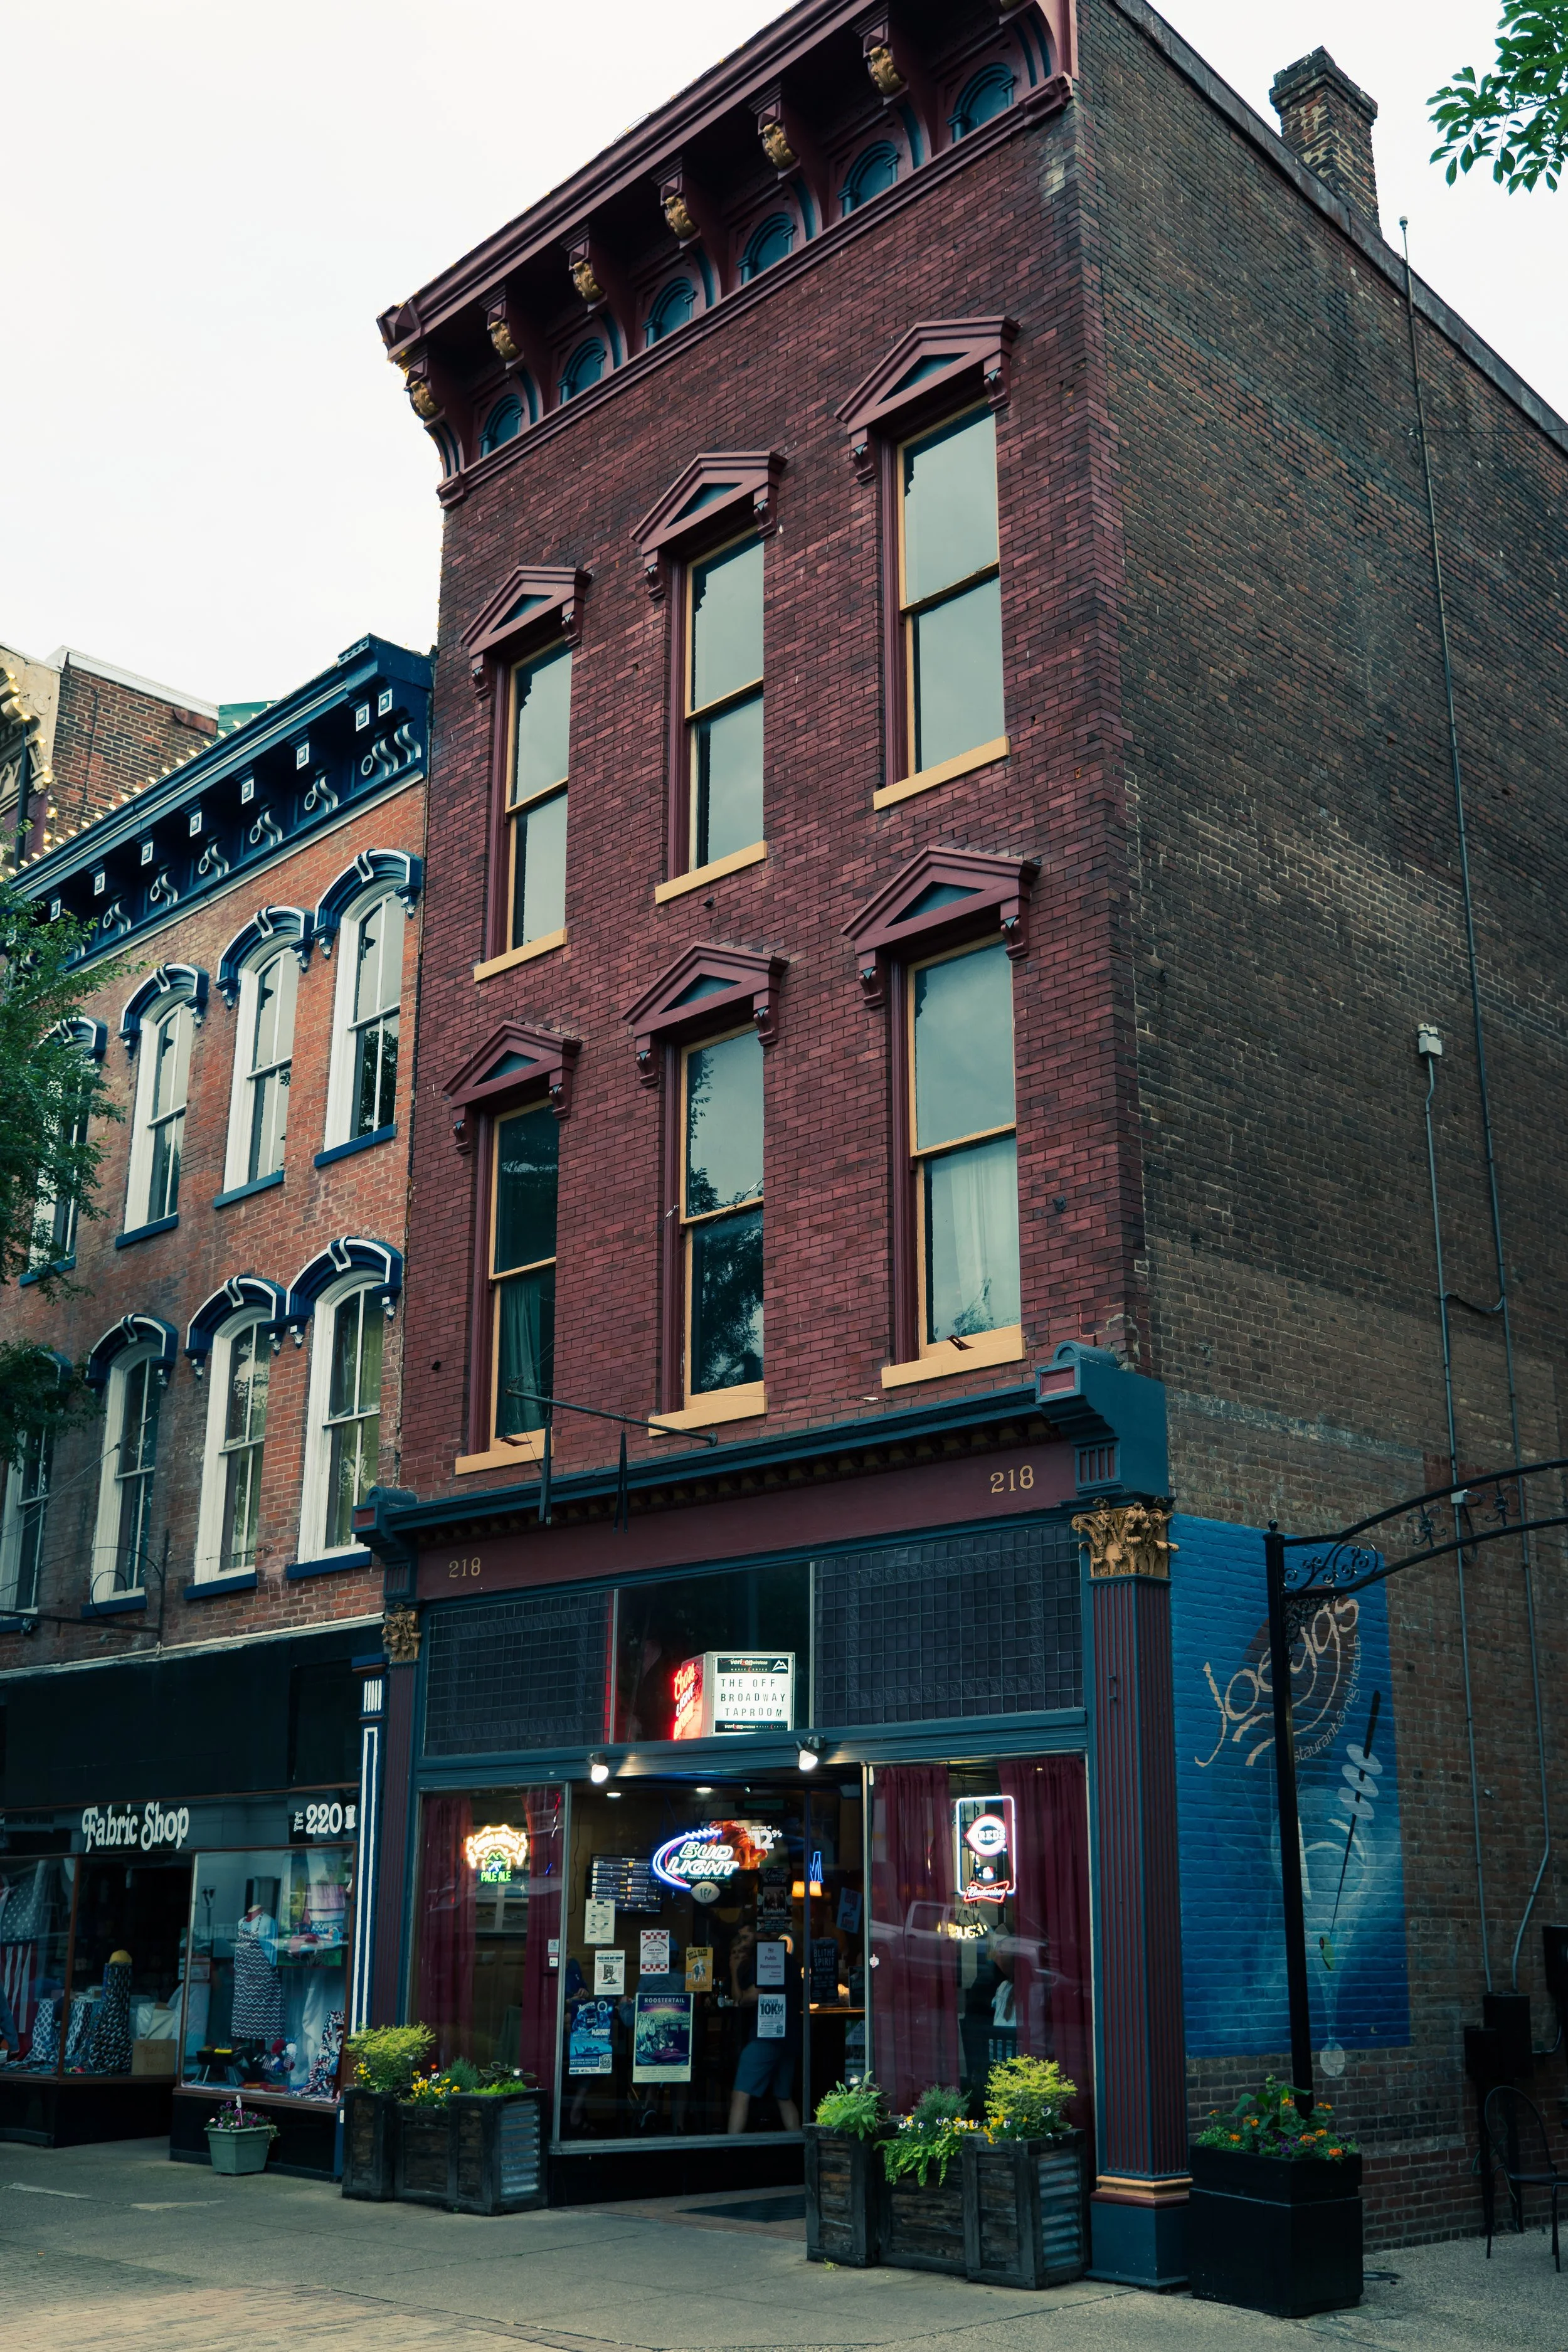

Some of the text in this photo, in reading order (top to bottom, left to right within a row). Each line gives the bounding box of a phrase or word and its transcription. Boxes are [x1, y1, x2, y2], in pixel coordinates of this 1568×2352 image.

[990, 1465, 1034, 1493] 218
[449, 1557, 481, 1578] 218
[721, 1678, 775, 1688] THE OFF
[721, 1693, 785, 1702] BROADWAY
[725, 1707, 782, 1718] TAPROOM
[1295, 1722, 1340, 1763] staurant
[306, 1803, 342, 1835] 220
[82, 1801, 189, 1853] Fabric Shop
[978, 1828, 1006, 1840] REDS
[679, 1841, 734, 1861] BUD
[665, 1856, 740, 1876] LIGHT
[480, 1870, 512, 1882] PALE ALE
[967, 1885, 1006, 1898] Budweiser
[813, 1948, 835, 1957] BLITHE
[813, 1957, 835, 1967] SPIRIT
[760, 2003, 780, 2015] 10K
